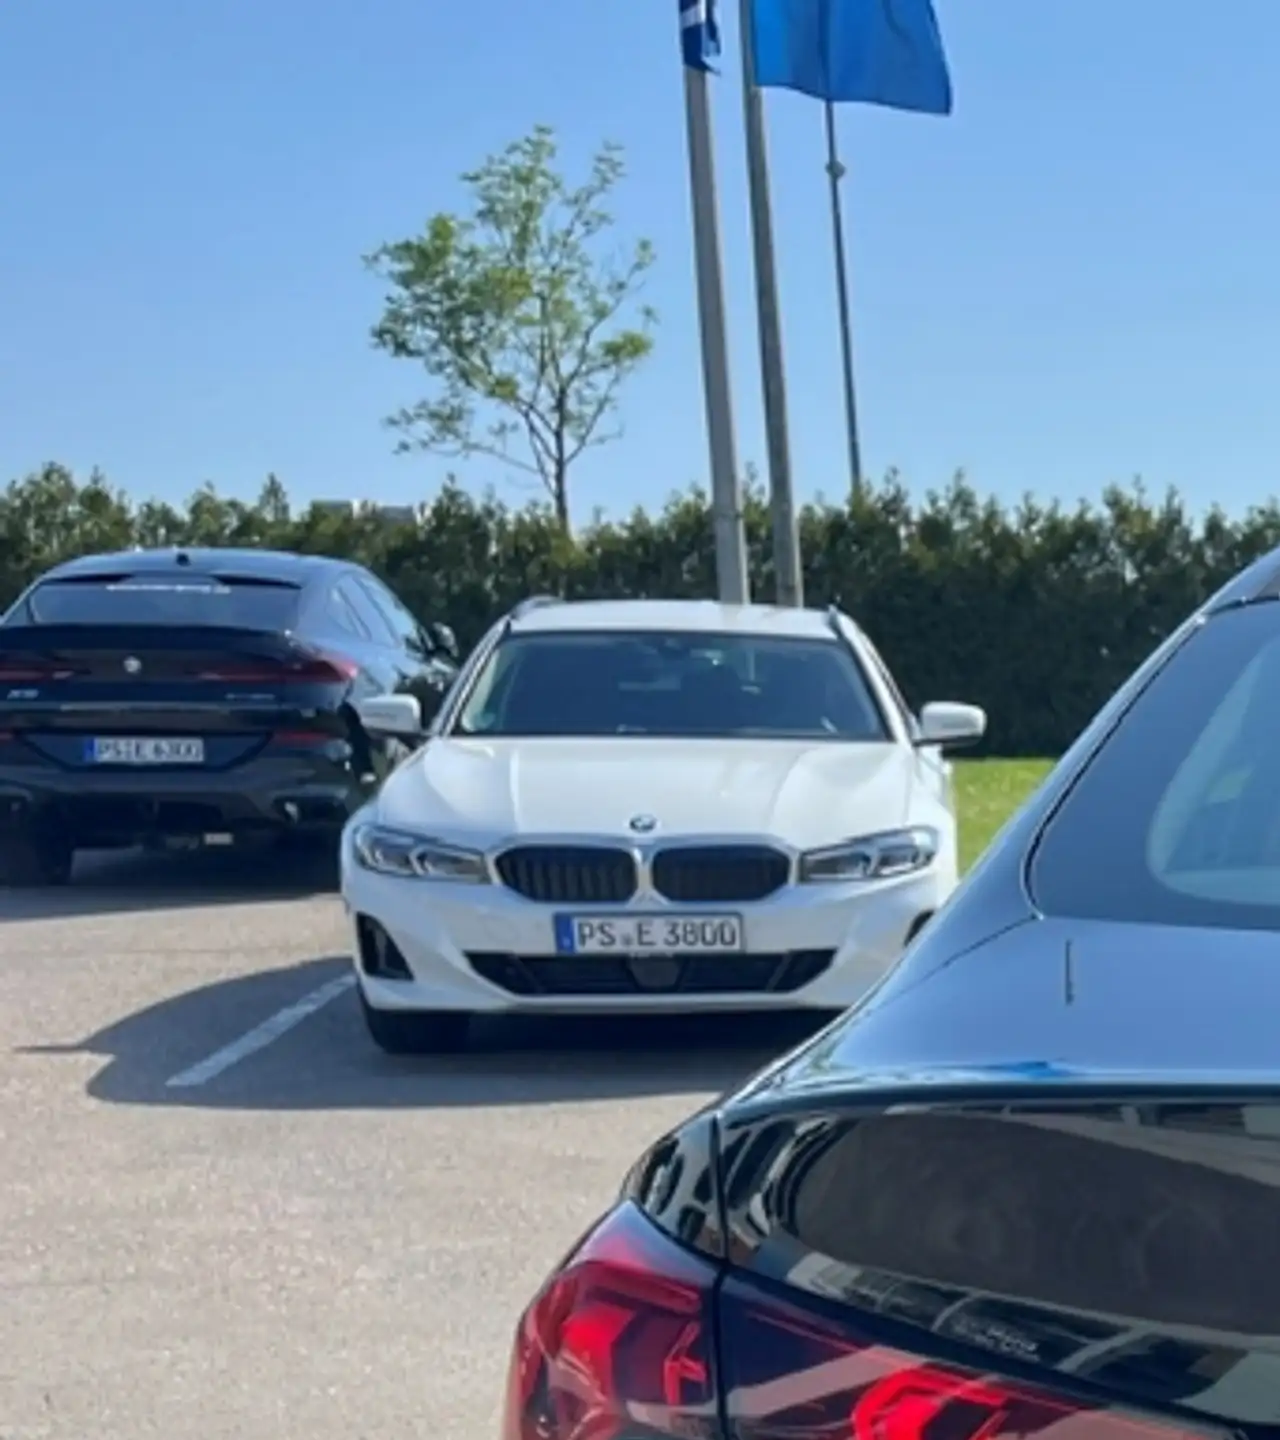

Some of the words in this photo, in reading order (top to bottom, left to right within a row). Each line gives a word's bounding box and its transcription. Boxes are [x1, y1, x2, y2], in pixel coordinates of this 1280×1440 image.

[579, 922, 616, 946] PS
[637, 922, 656, 946] E
[663, 921, 737, 947] 3800
